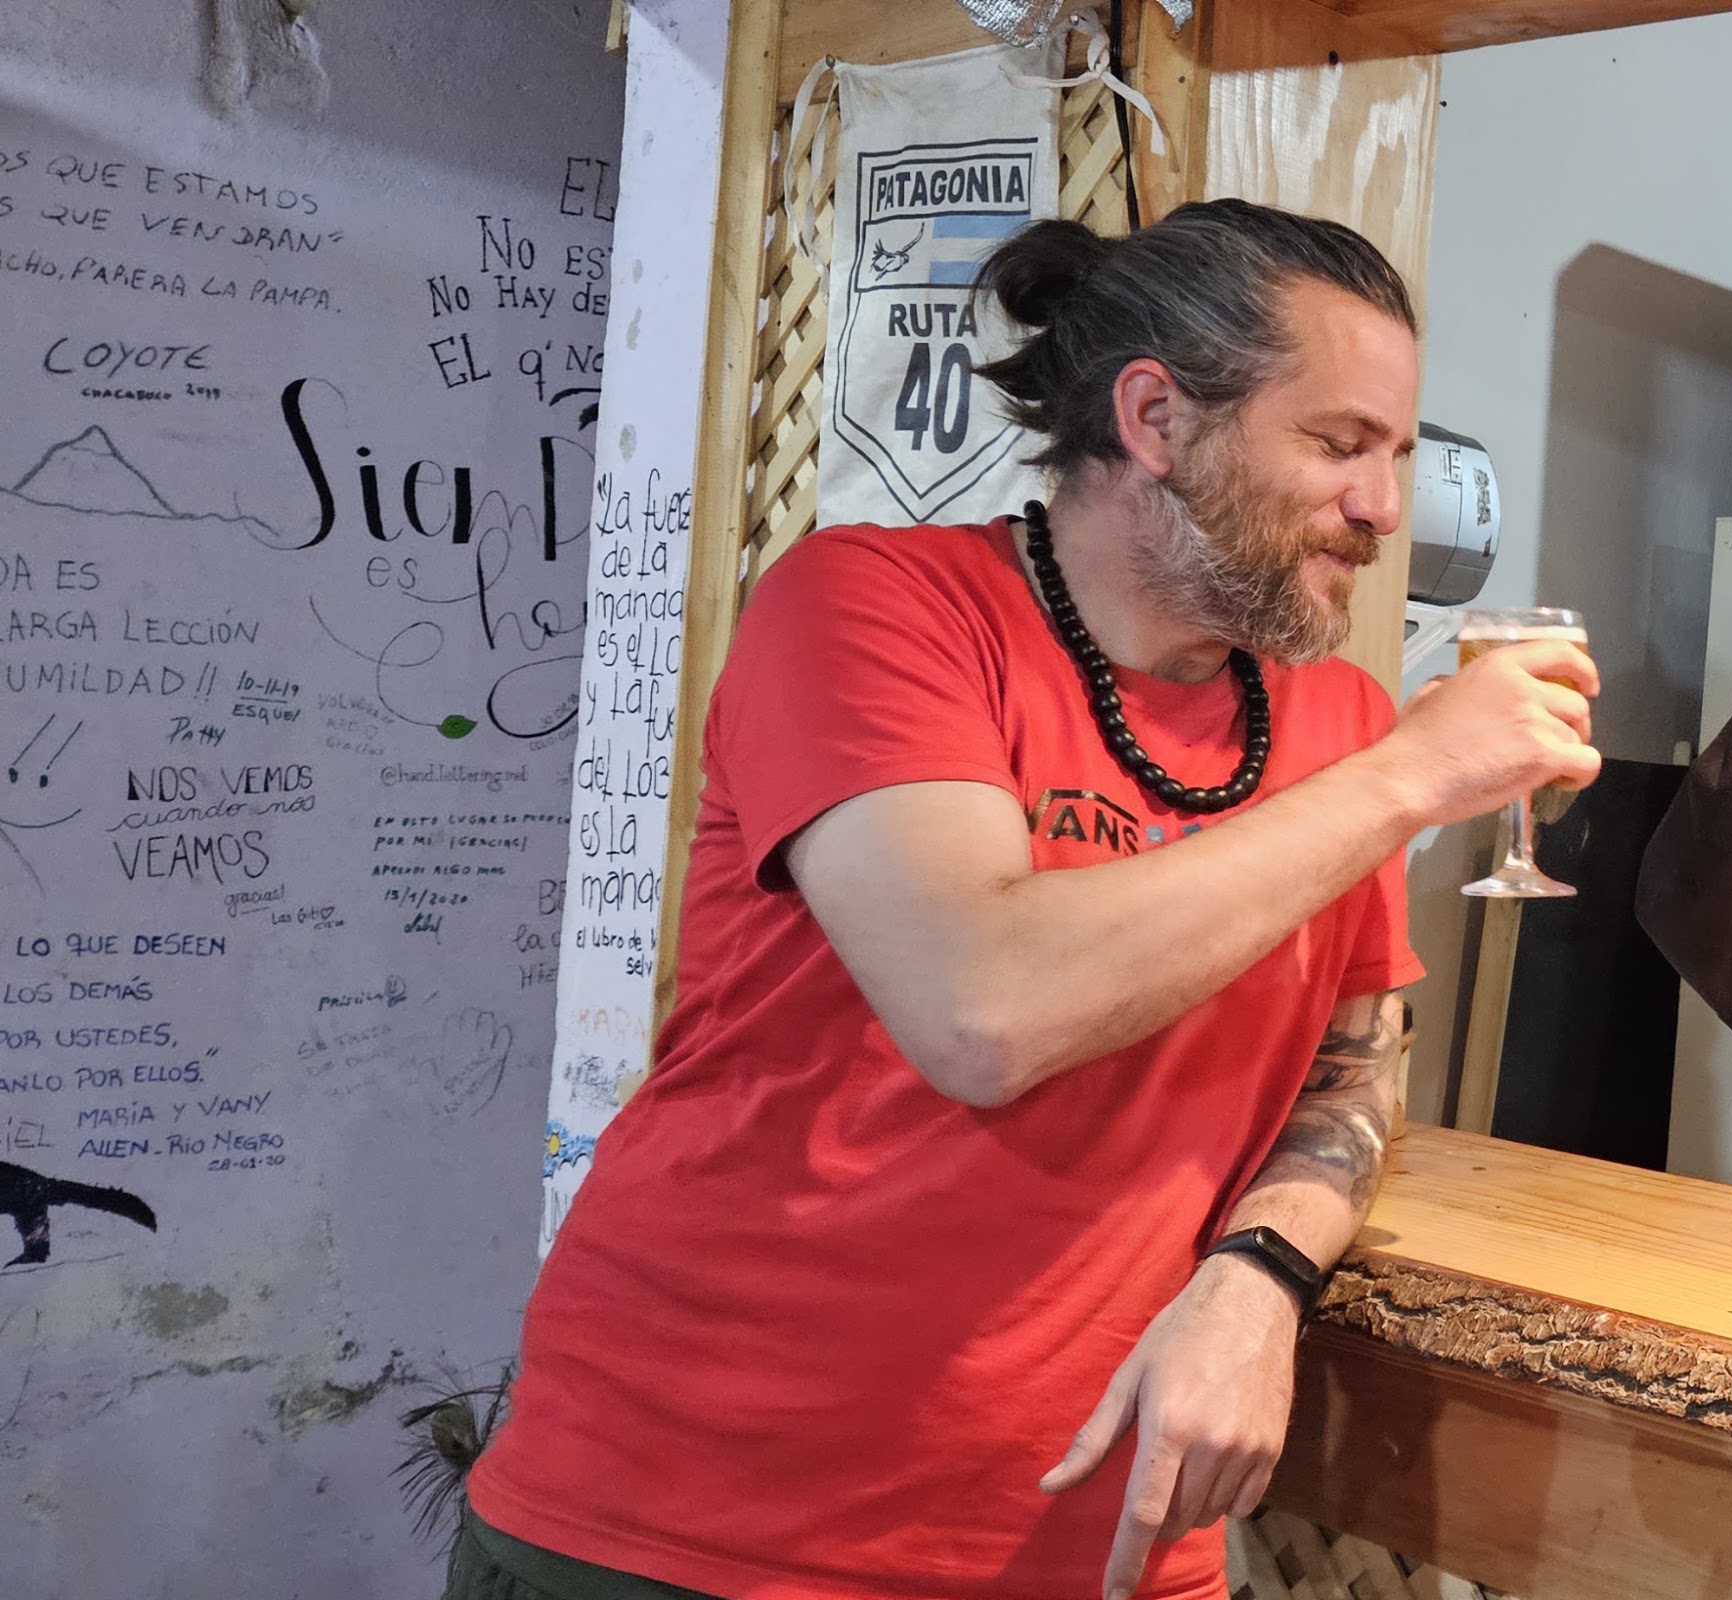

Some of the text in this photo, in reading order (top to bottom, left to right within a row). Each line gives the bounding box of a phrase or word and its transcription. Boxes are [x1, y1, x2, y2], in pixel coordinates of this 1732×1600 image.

[46, 155, 126, 188] QUE
[145, 166, 319, 215] ESTAMOS
[876, 165, 1025, 213] PATAGONIA
[41, 204, 111, 230] QUE
[202, 276, 237, 298] LA
[888, 302, 979, 338] RUTA
[43, 337, 211, 379] COYOTE
[428, 332, 492, 389] EL
[895, 342, 973, 455] 40
[57, 561, 100, 591] ES
[366, 556, 418, 590] es
[601, 540, 631, 578] de
[0, 609, 98, 642] ARGA
[598, 629, 618, 667] es
[127, 764, 313, 802] NOS VEMOS
[105, 794, 316, 832] cuando nos
[1024, 788, 1139, 856] VANS
[580, 810, 600, 857] es
[113, 830, 270, 886] VEAMOS
[16, 935, 51, 958] LO
[133, 933, 226, 957] DESEEN
[69, 976, 153, 1001] DEMÁS
[75, 1067, 124, 1089] POR
[198, 1090, 272, 1117] VANY
[213, 1129, 284, 1151] NEGRO
